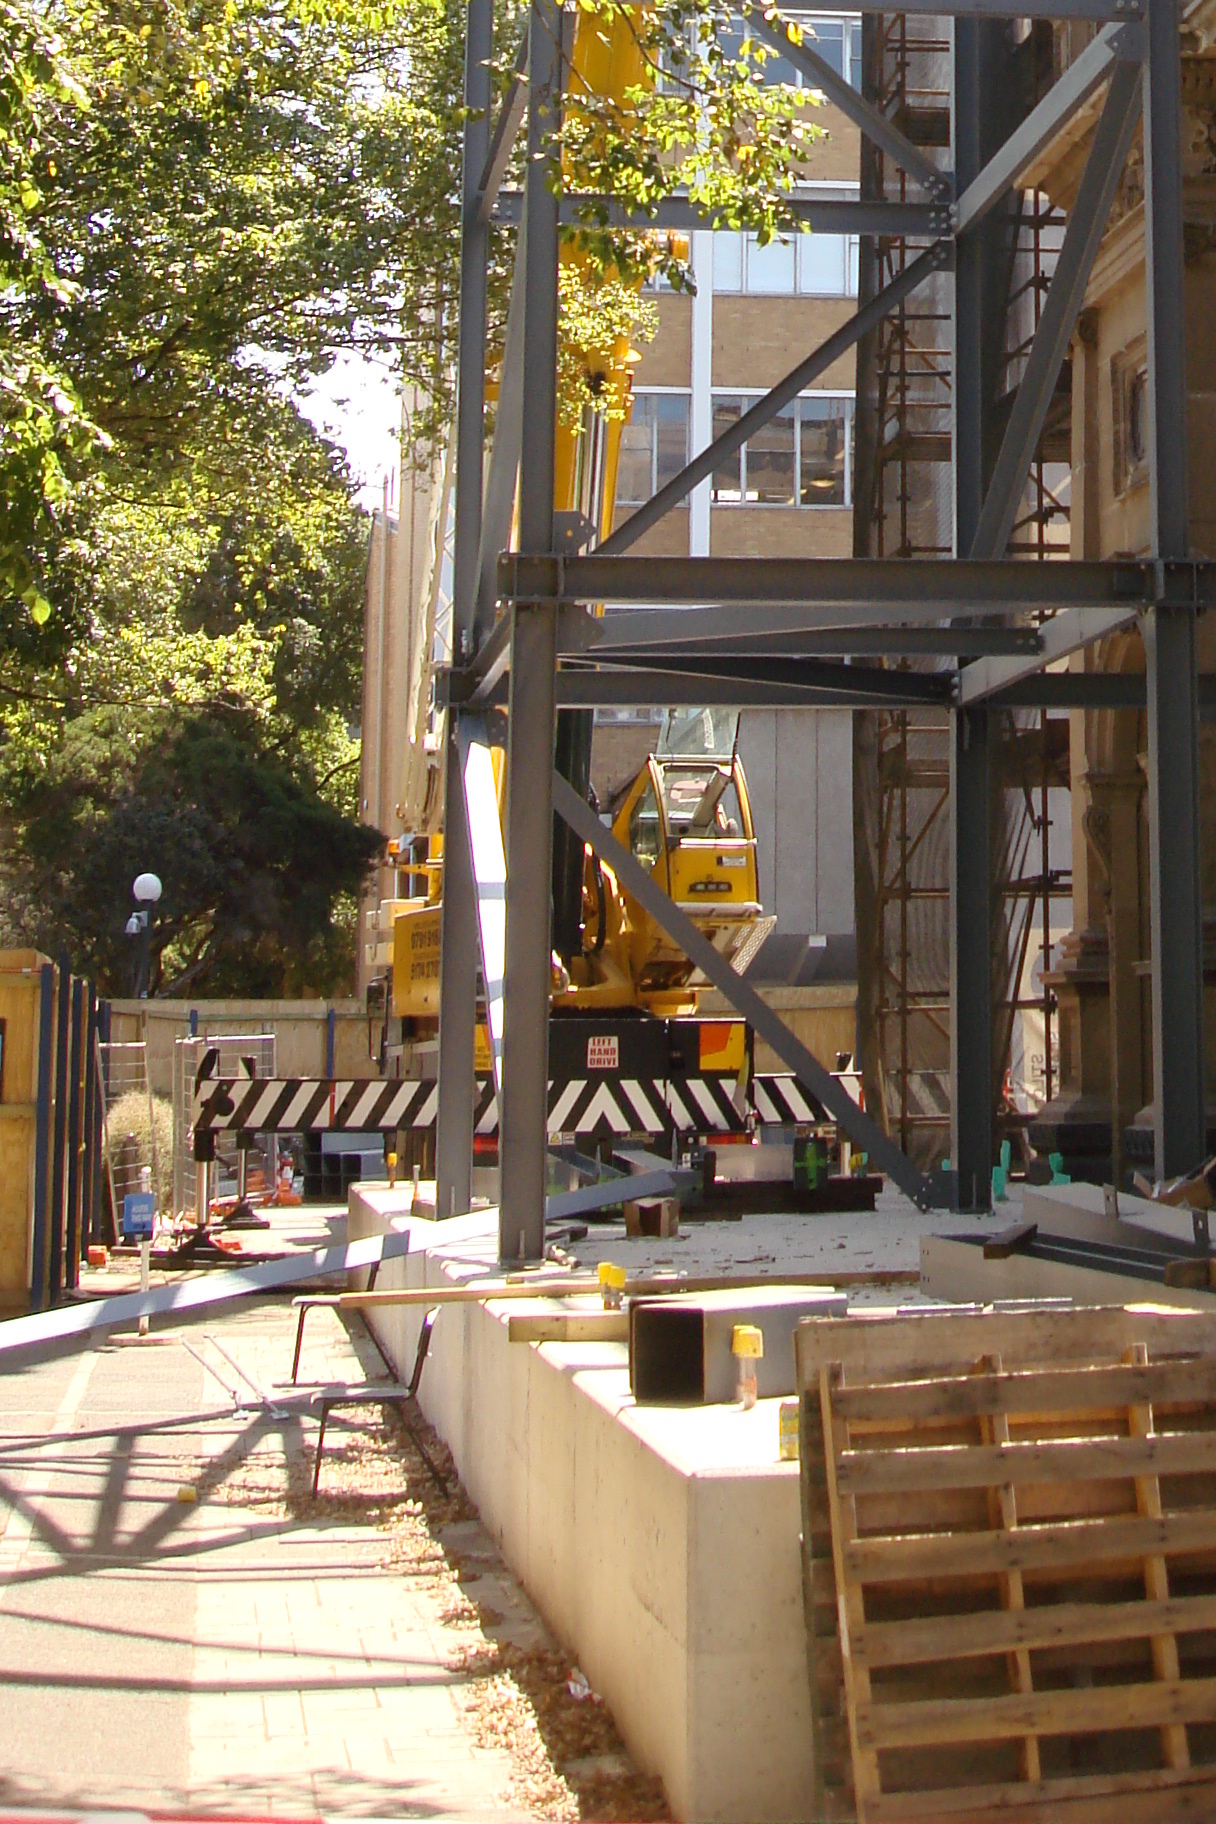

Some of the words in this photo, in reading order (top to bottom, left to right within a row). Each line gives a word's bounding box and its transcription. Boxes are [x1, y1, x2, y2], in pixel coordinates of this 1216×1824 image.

[592, 1037, 612, 1046] LEFT
[590, 1047, 616, 1056] HAND
[589, 1057, 616, 1066] DRIVE
